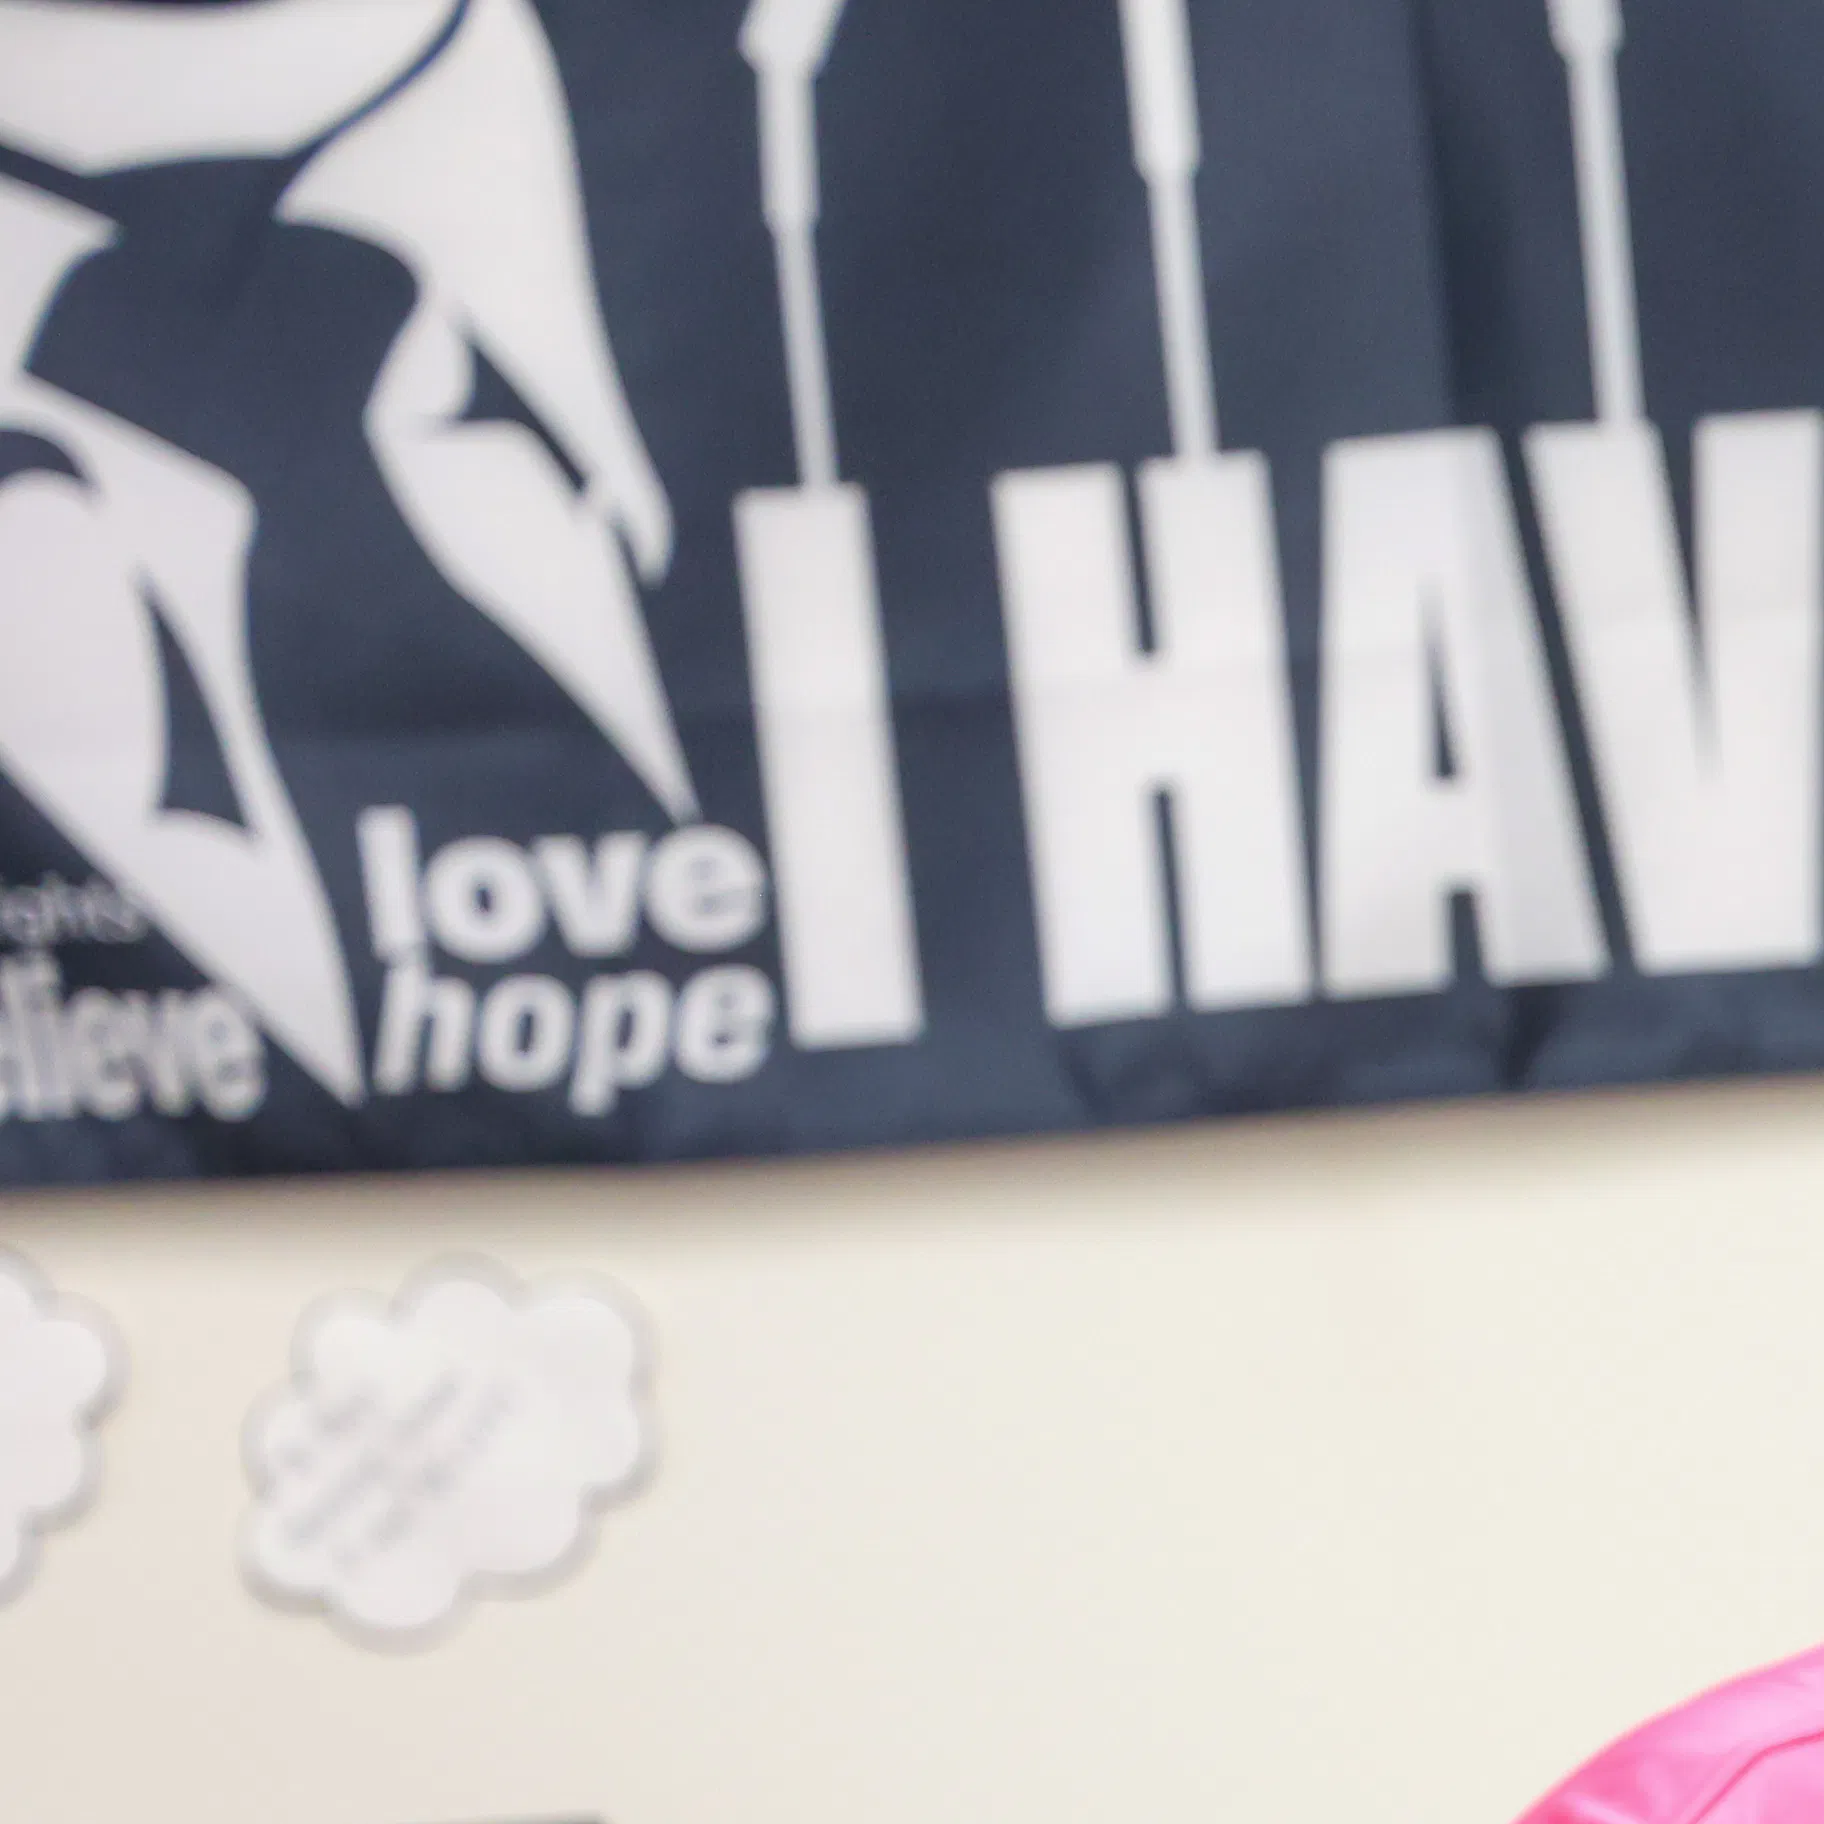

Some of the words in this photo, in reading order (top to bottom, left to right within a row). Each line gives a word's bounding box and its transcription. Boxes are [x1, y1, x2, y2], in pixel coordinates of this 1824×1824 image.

[735, 480, 923, 1048] I
[355, 803, 768, 964] love
[0, 952, 268, 1124] lieve
[372, 948, 775, 1118] hope
